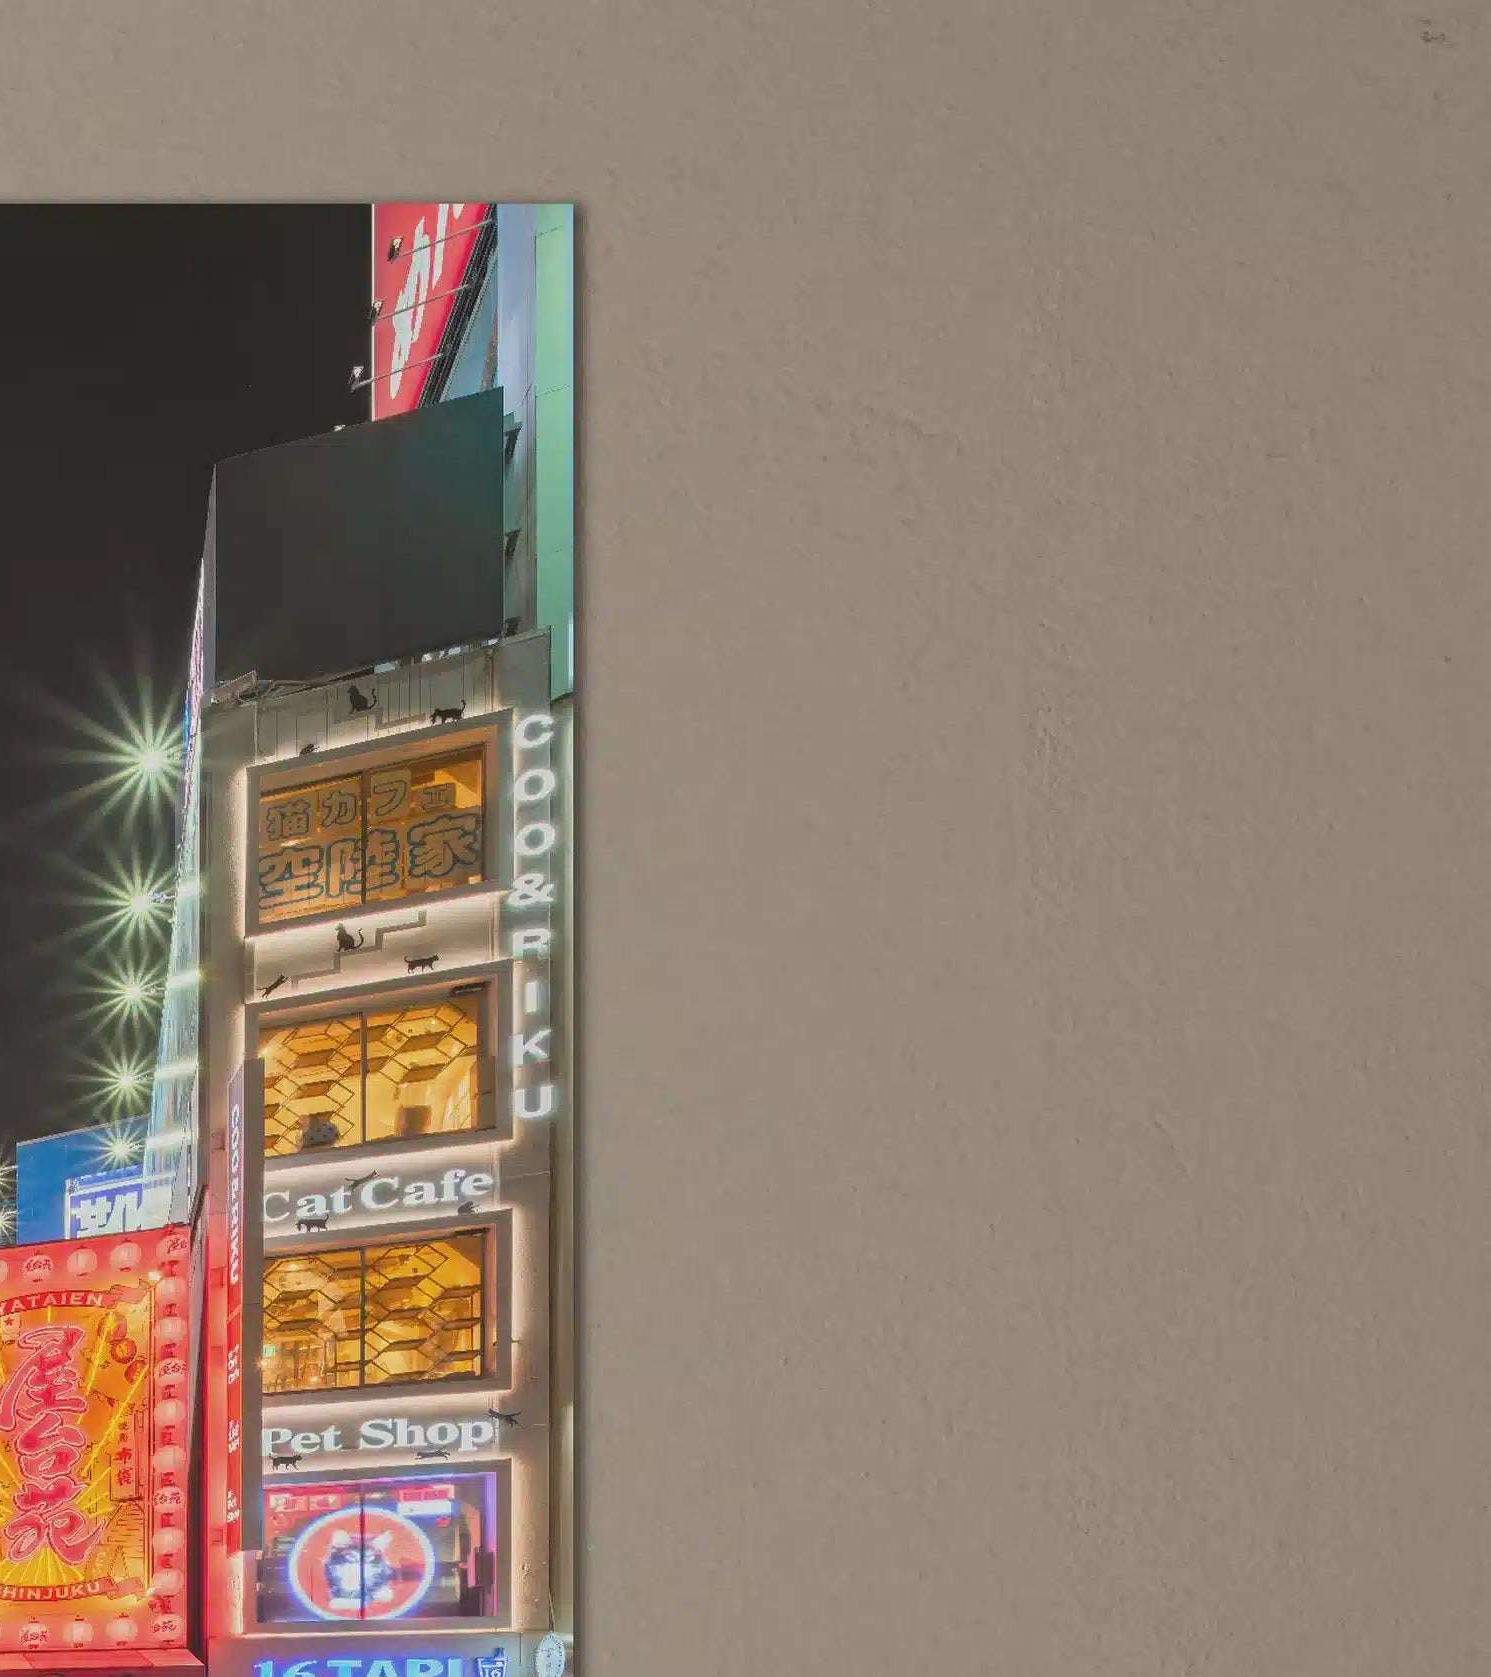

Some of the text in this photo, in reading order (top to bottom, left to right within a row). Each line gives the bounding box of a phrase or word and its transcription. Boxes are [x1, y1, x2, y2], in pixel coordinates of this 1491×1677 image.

[265, 768, 456, 841] 猫カフェ
[259, 812, 482, 910] 空陸家
[513, 714, 556, 1119] COO&RIKU
[263, 1169, 494, 1222] Cat Cafe
[263, 1425, 343, 1455] Pet
[360, 1418, 493, 1451] Shop
